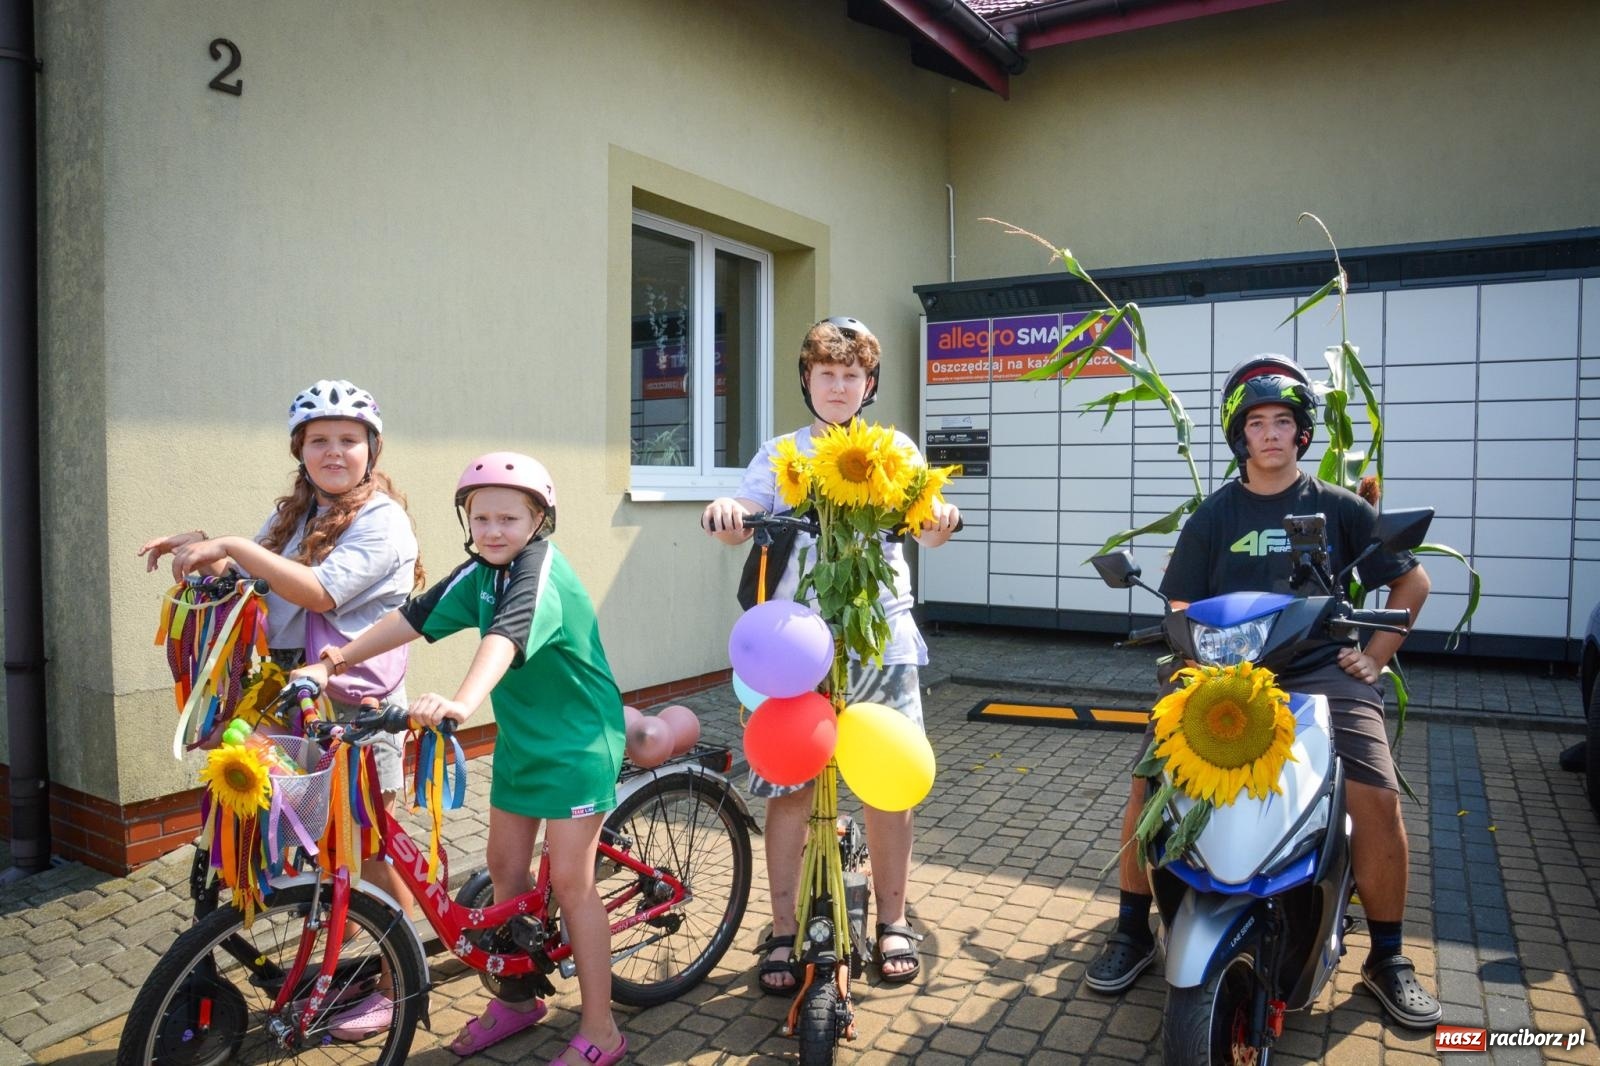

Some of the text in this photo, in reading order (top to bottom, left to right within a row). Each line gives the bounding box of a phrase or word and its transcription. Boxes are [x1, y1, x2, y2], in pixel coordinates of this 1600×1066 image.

[208, 37, 243, 97] 2
[938, 326, 1015, 353] allegro
[931, 360, 1003, 374] Oszczędzaj
[1007, 360, 1023, 370] na
[1230, 529, 1287, 556] 4F
